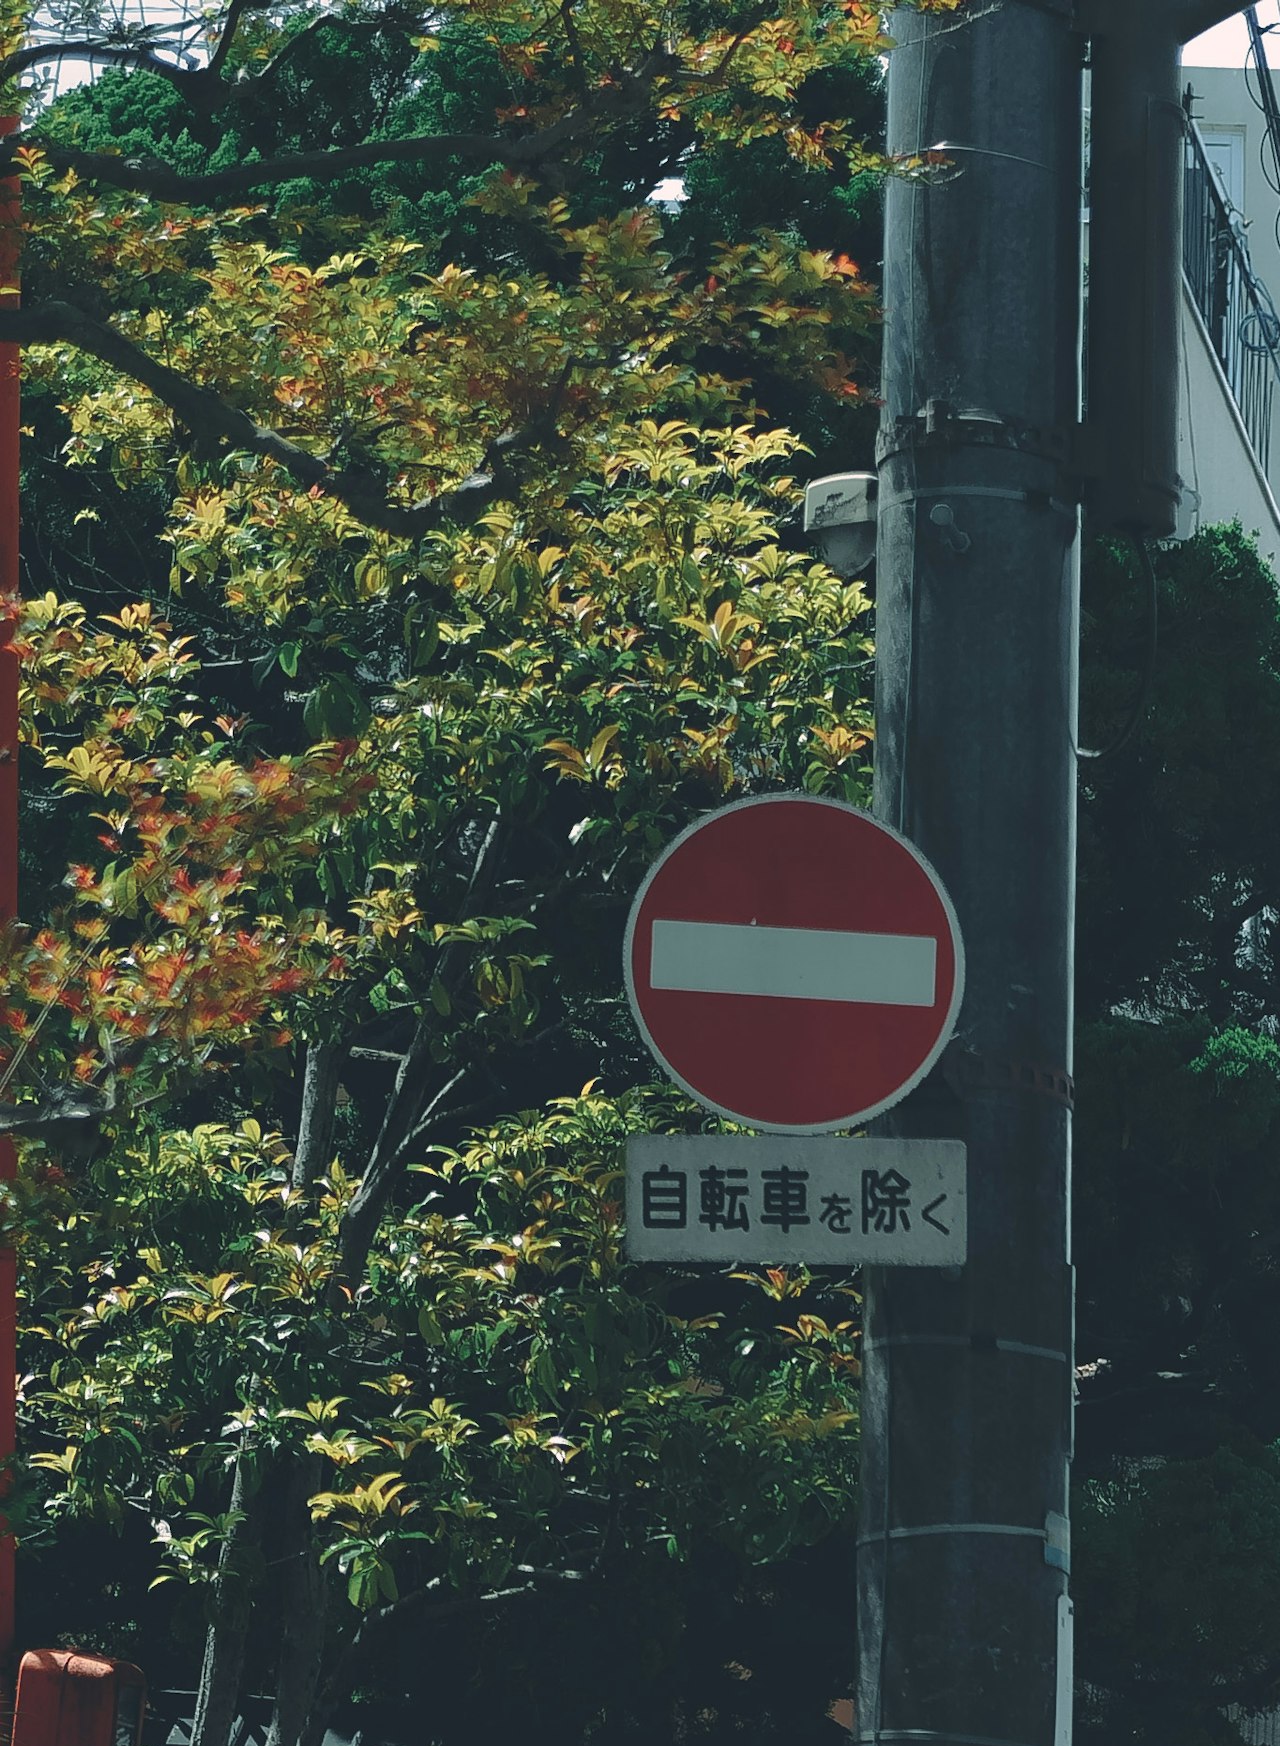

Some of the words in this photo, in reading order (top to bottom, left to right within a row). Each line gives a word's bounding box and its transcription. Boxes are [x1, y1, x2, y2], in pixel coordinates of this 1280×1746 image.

[643, 1164, 950, 1236] 自転車を除く
